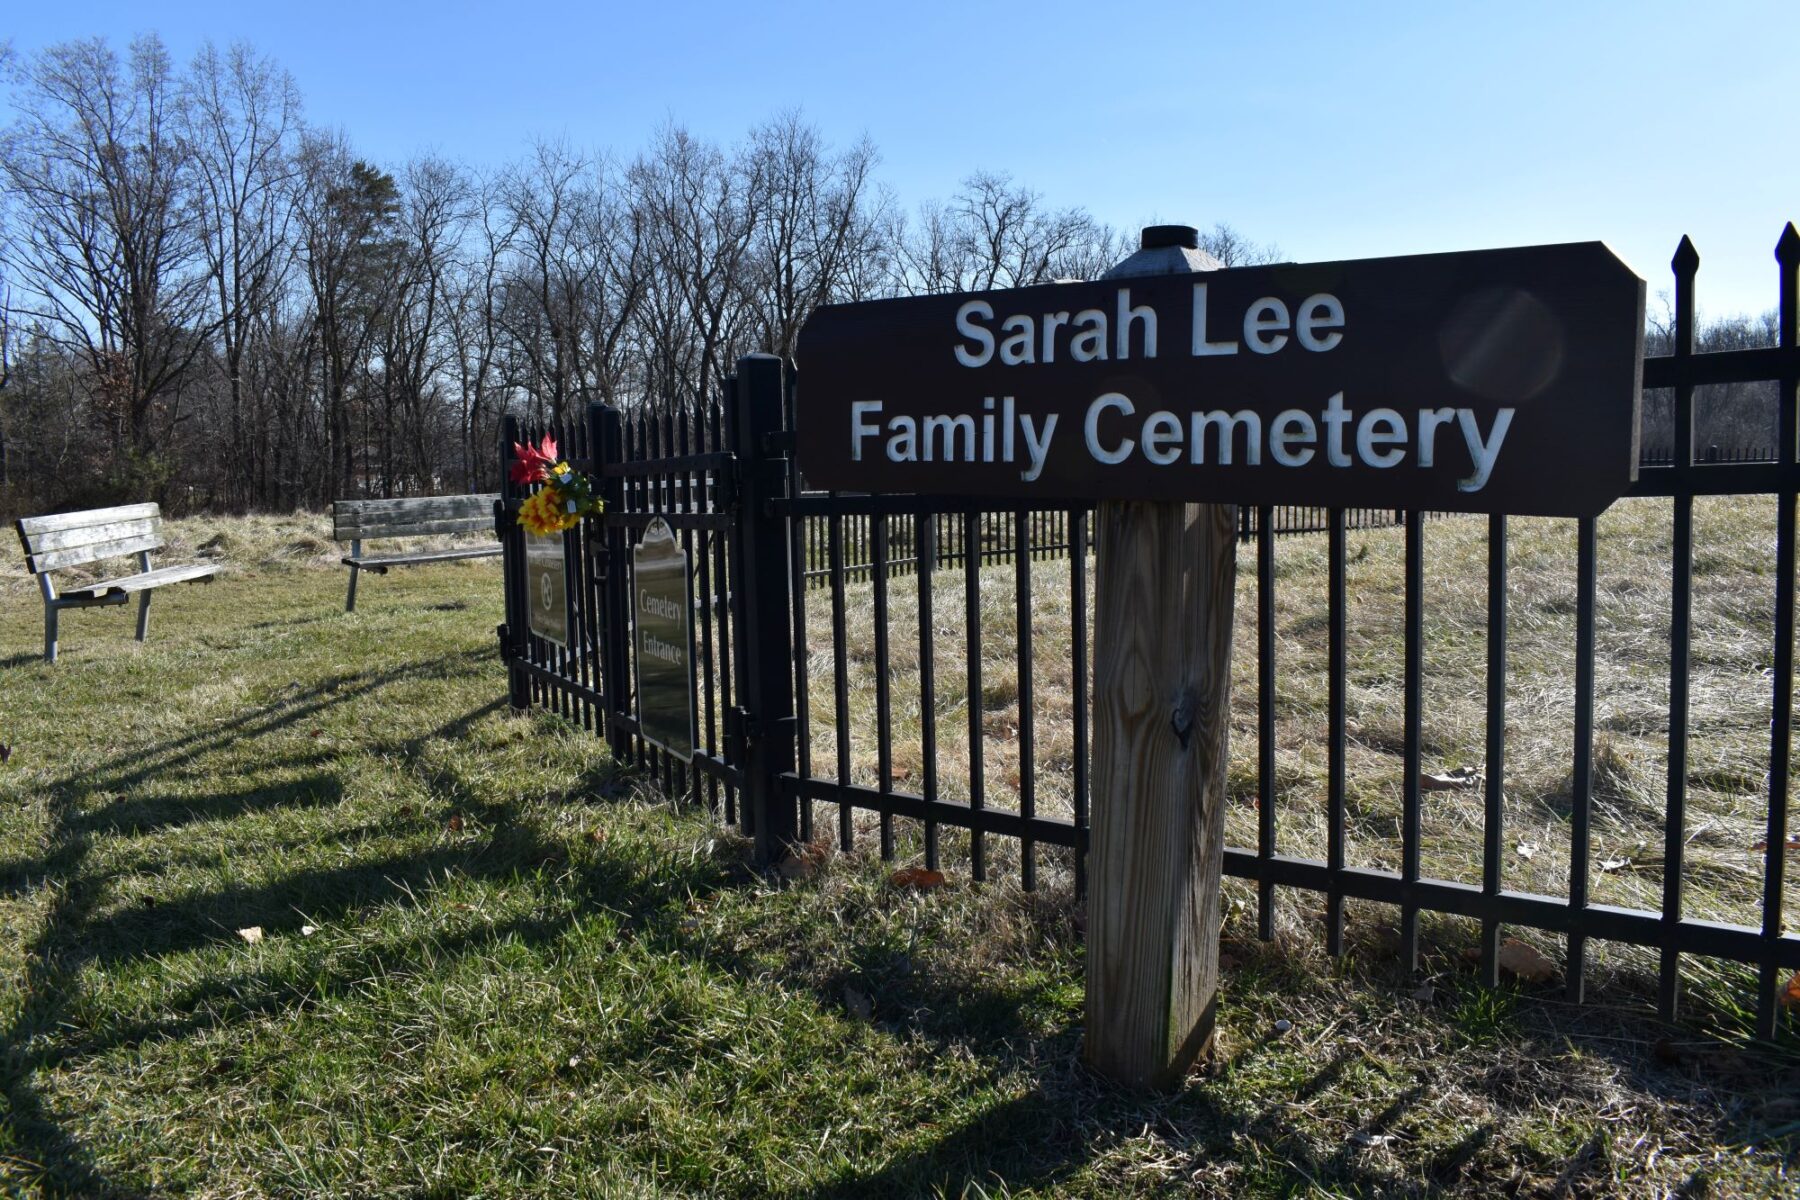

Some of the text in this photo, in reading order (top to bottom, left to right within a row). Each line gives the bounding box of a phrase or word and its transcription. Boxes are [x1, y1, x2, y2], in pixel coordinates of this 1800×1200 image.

[954, 282, 1346, 367] Sarah Lee
[852, 391, 1516, 493] Family Cemetery
[640, 588, 682, 630] Cemetery
[643, 630, 682, 665] Entrance
